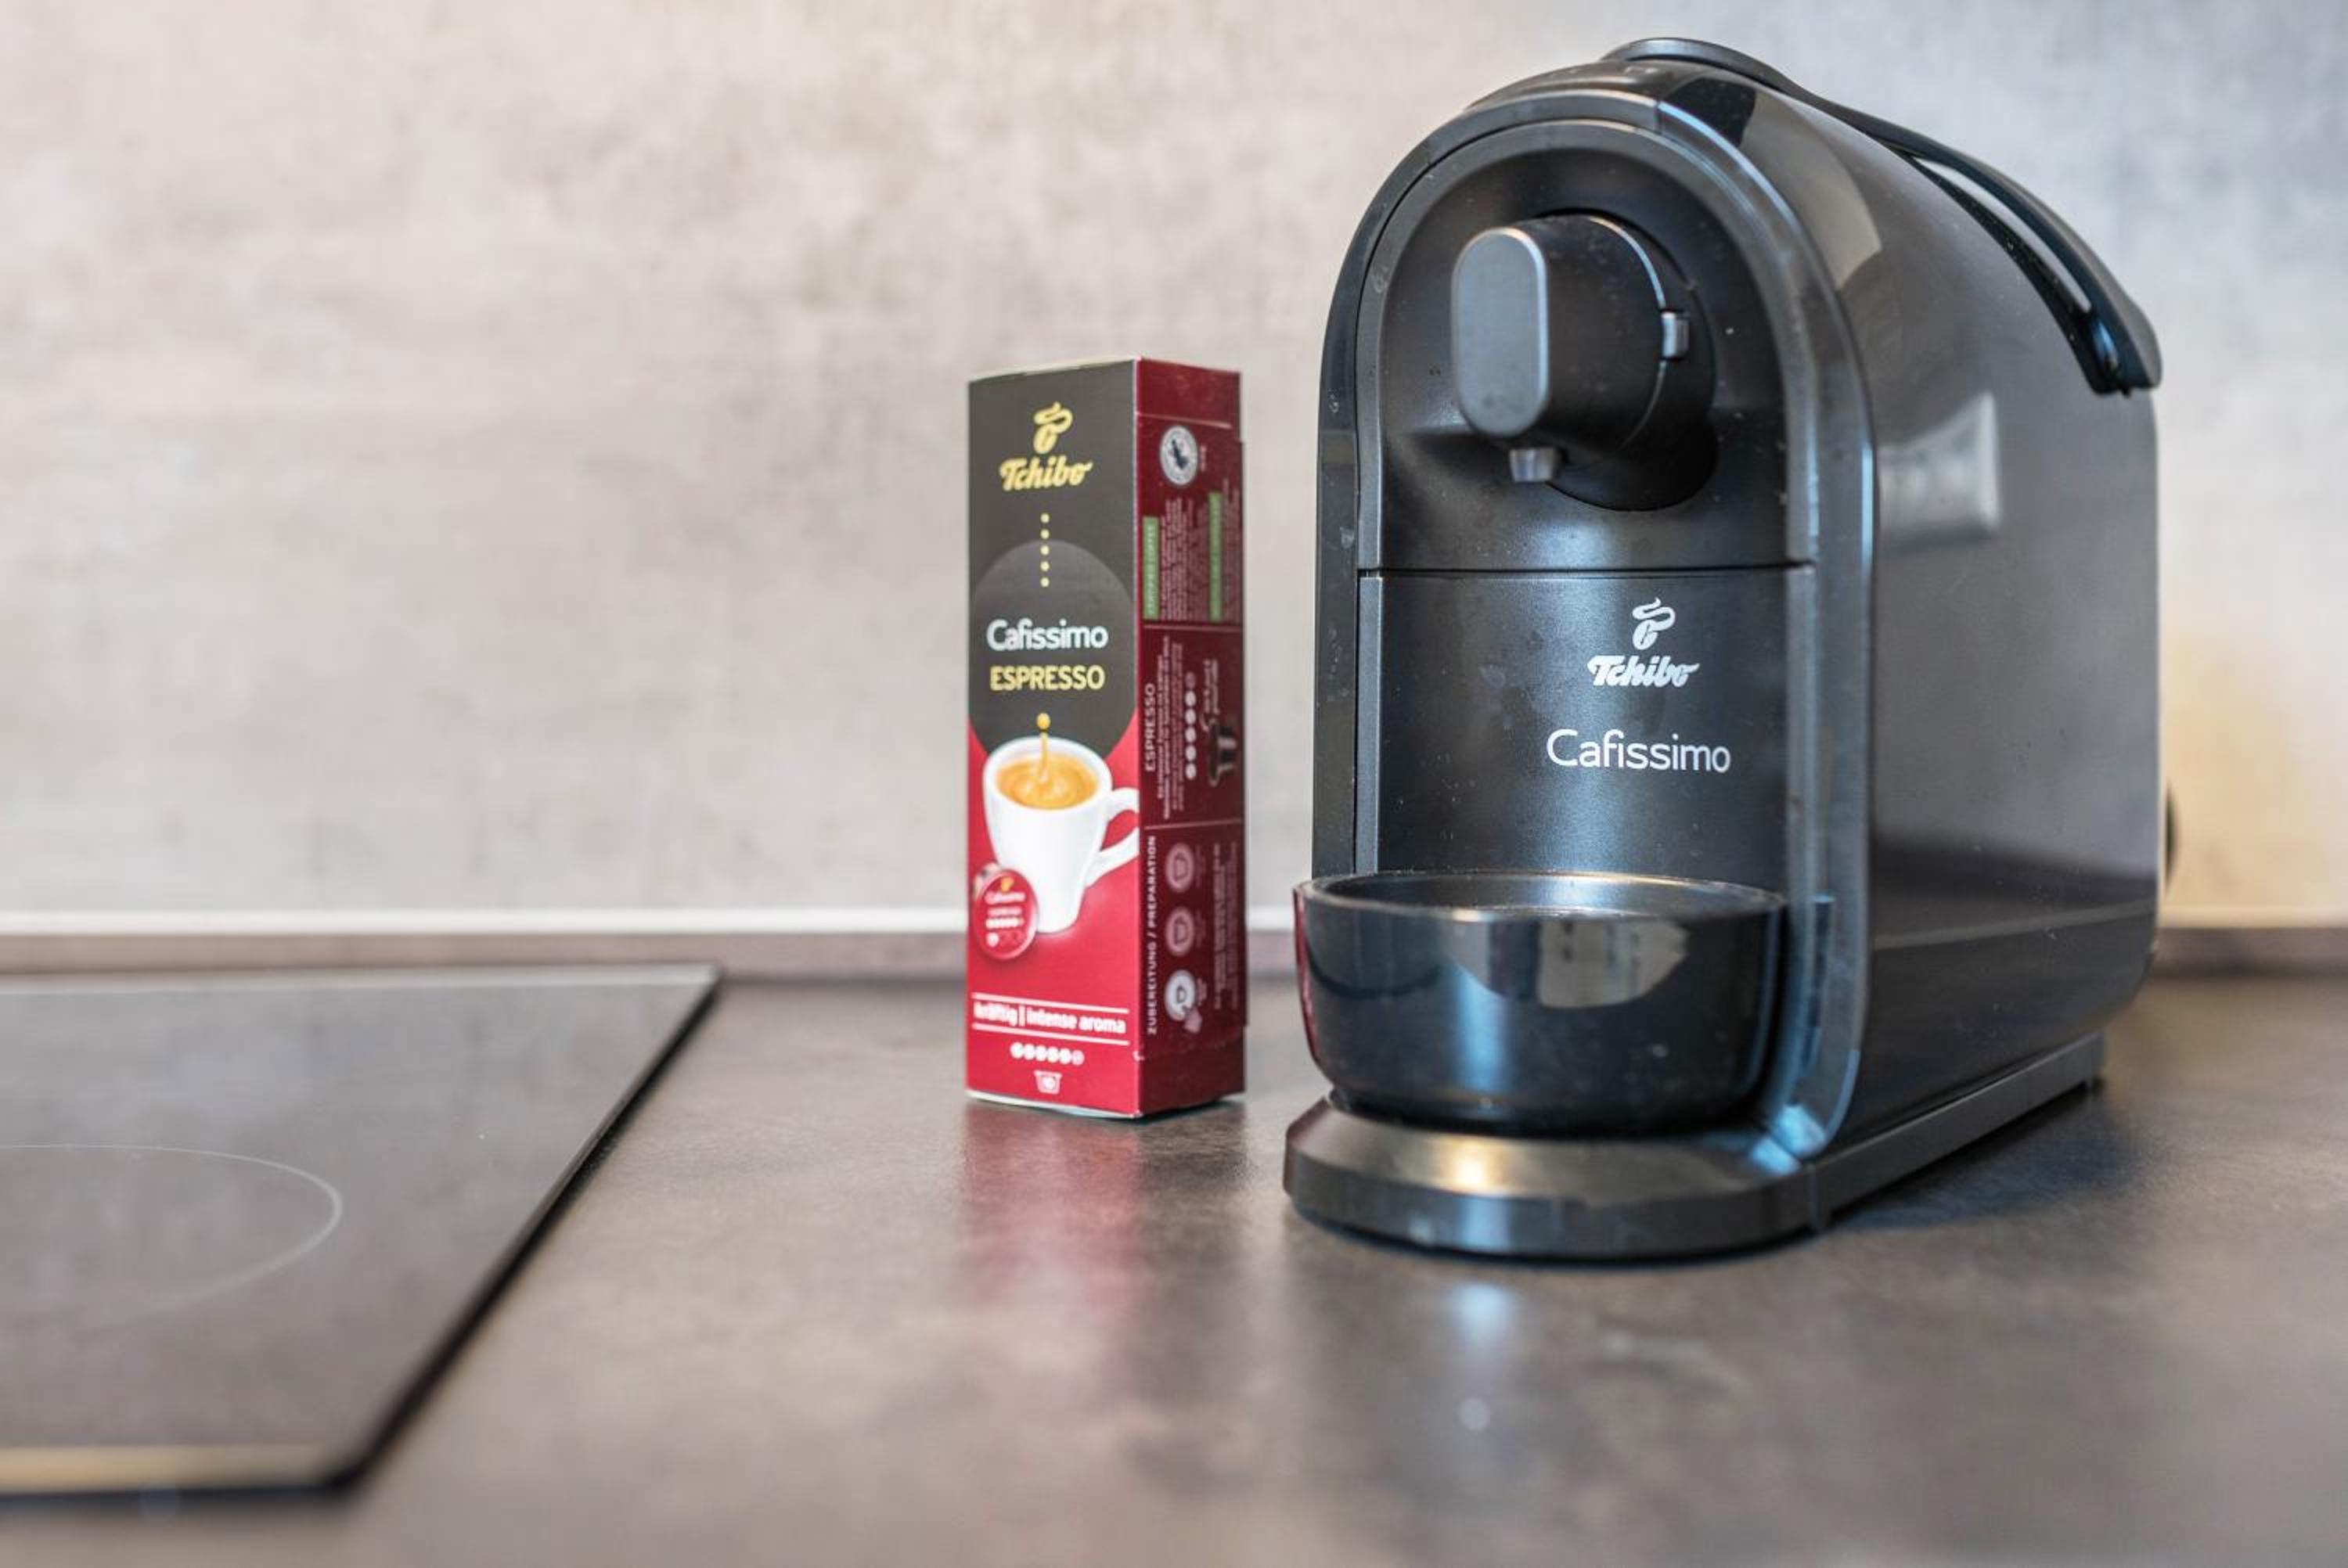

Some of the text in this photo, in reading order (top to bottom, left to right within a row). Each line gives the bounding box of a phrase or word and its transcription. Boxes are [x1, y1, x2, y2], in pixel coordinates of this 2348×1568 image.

[999, 455, 1093, 491] Tchibo
[986, 617, 1109, 651] Cafissimo
[989, 664, 1105, 691] ESPRESSO
[1586, 655, 1700, 688] Tchibo
[1144, 682, 1156, 772] ESPRESSO
[1547, 728, 1731, 773] Cafissimo
[1147, 835, 1157, 928] PREPARATION
[1147, 941, 1158, 1036] ZUBEREITUNG
[1026, 1006, 1077, 1030] intense
[1078, 1015, 1126, 1034] aroma
